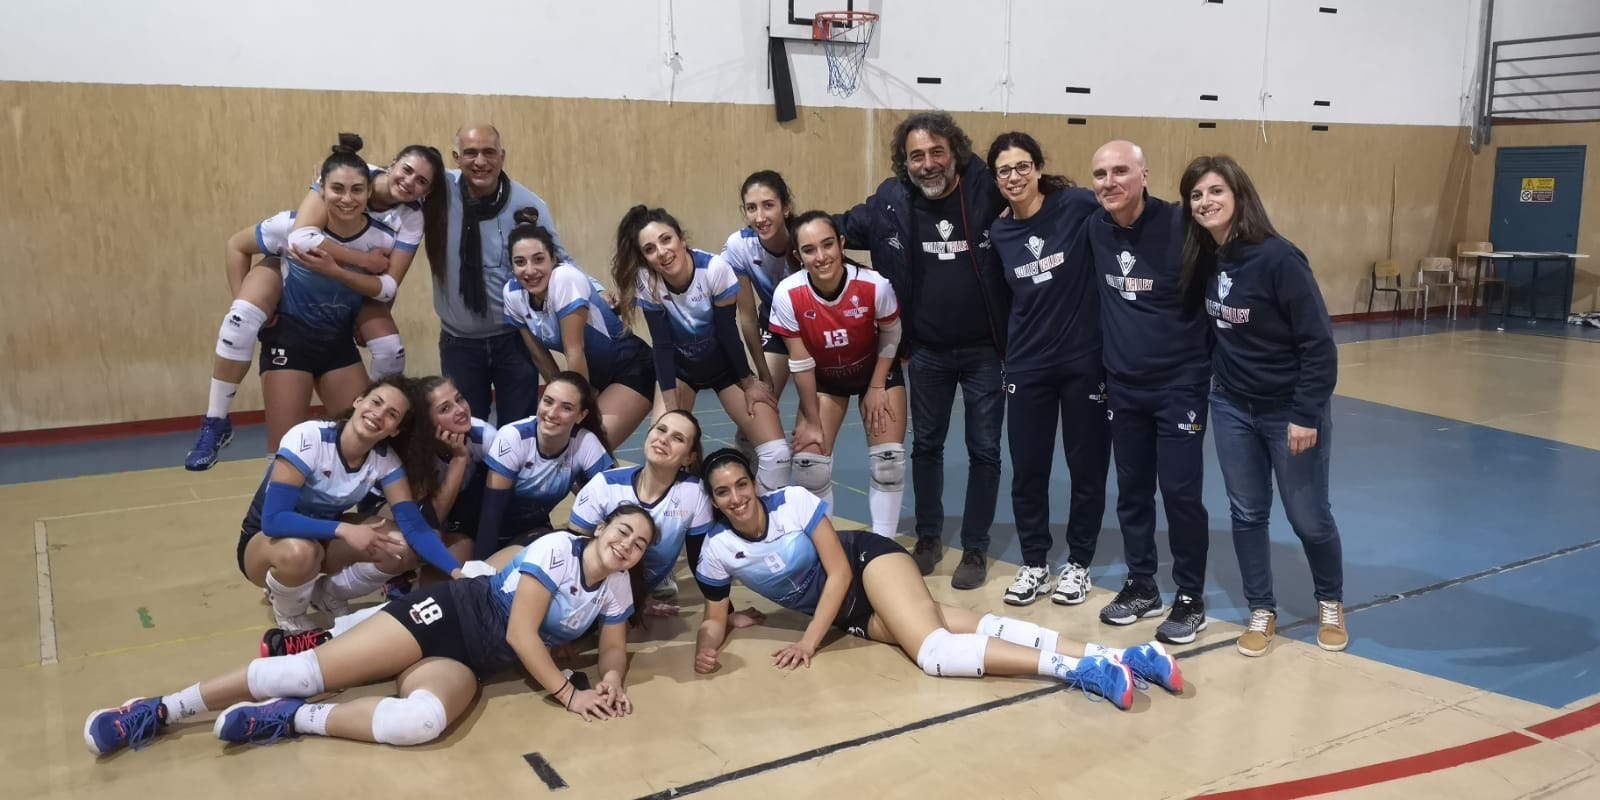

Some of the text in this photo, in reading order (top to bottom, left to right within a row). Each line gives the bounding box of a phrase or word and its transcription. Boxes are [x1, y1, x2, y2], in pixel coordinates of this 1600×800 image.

[1124, 277, 1154, 292] VALLEY
[1221, 304, 1250, 323] VALLEY
[823, 328, 849, 349] 13
[411, 596, 443, 626] 18
